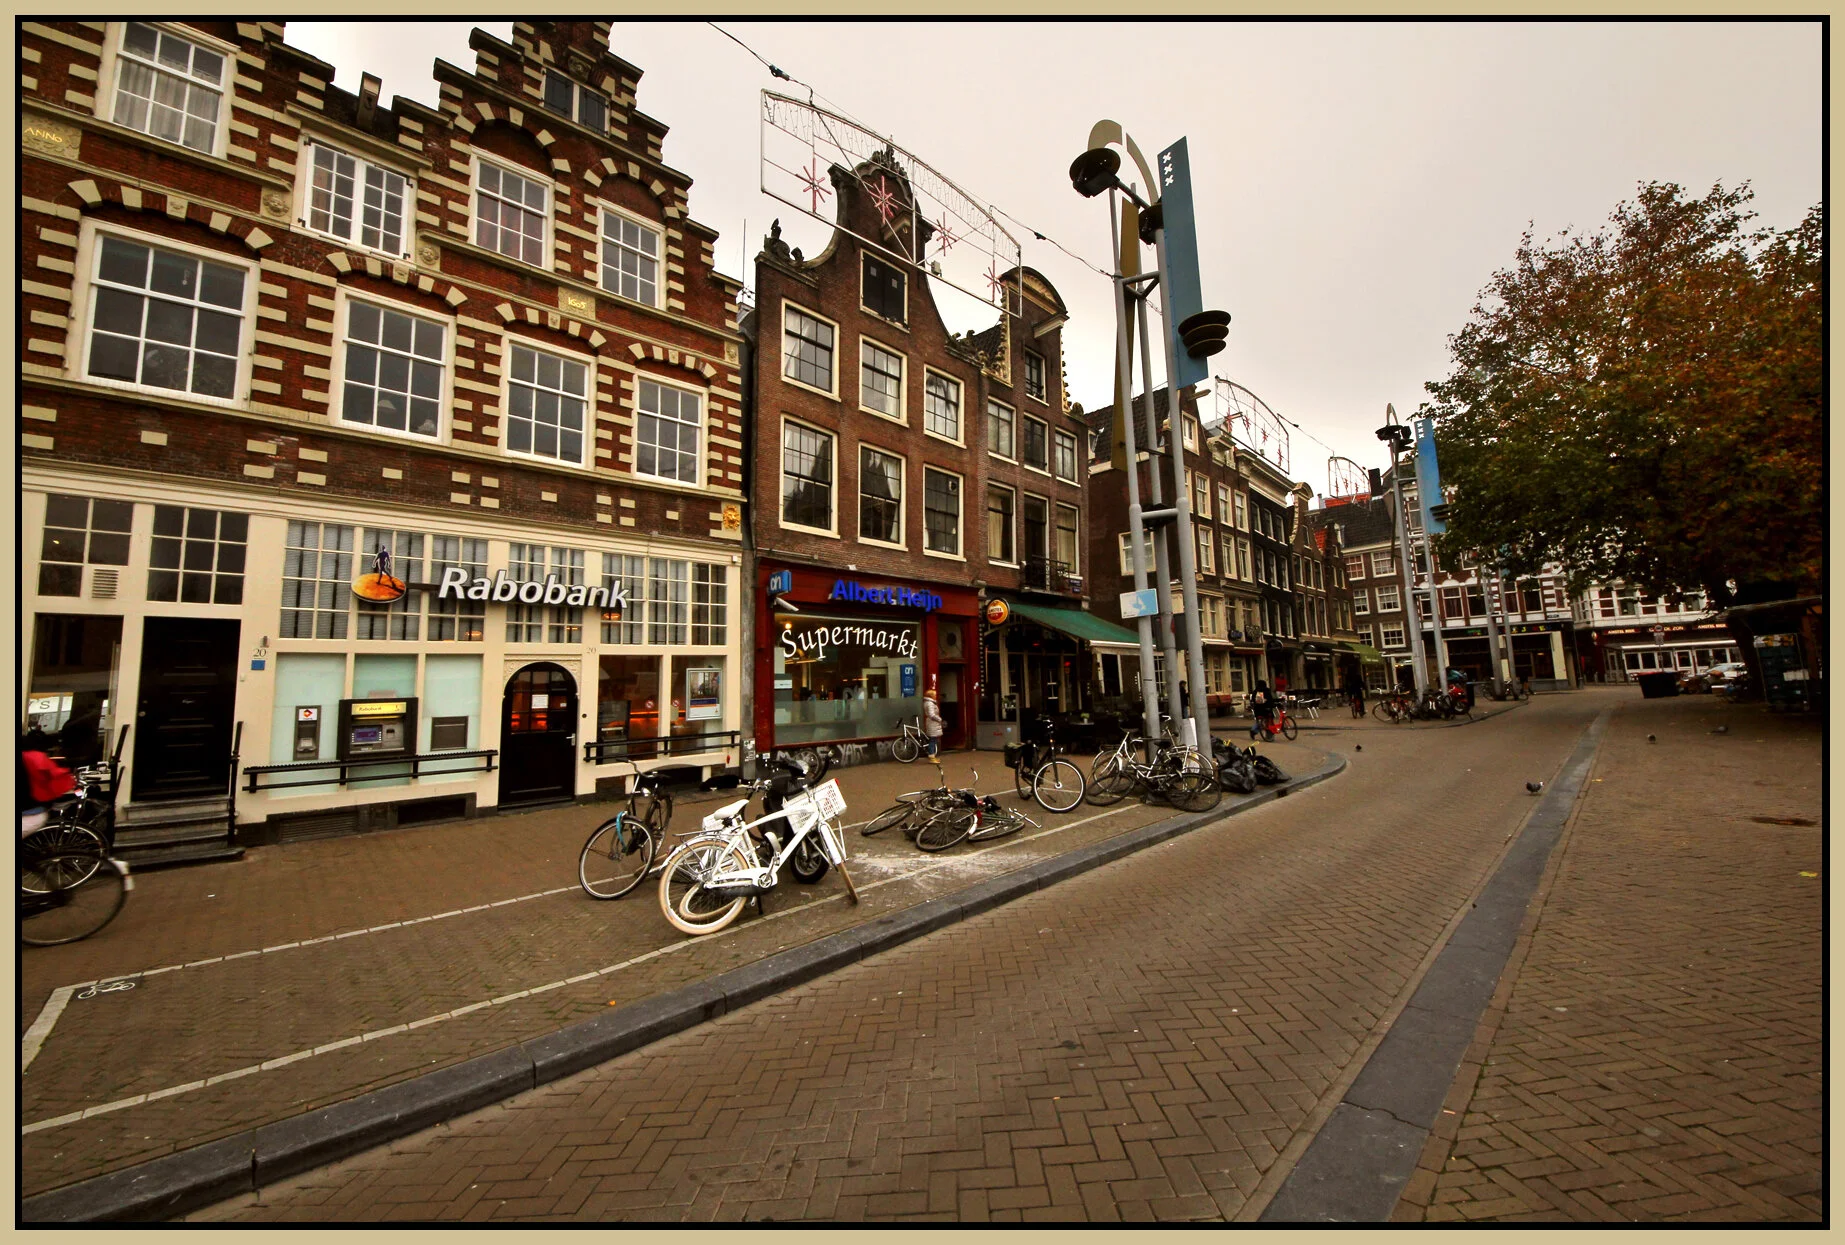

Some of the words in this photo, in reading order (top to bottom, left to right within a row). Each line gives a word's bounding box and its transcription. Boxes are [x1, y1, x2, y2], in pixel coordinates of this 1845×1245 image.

[24, 127, 63, 143] ANNO
[438, 566, 630, 609] Rabobank
[831, 579, 894, 604] Albert
[897, 586, 944, 612] Heijn
[252, 647, 267, 658] 20
[781, 625, 918, 660] Supermarkt
